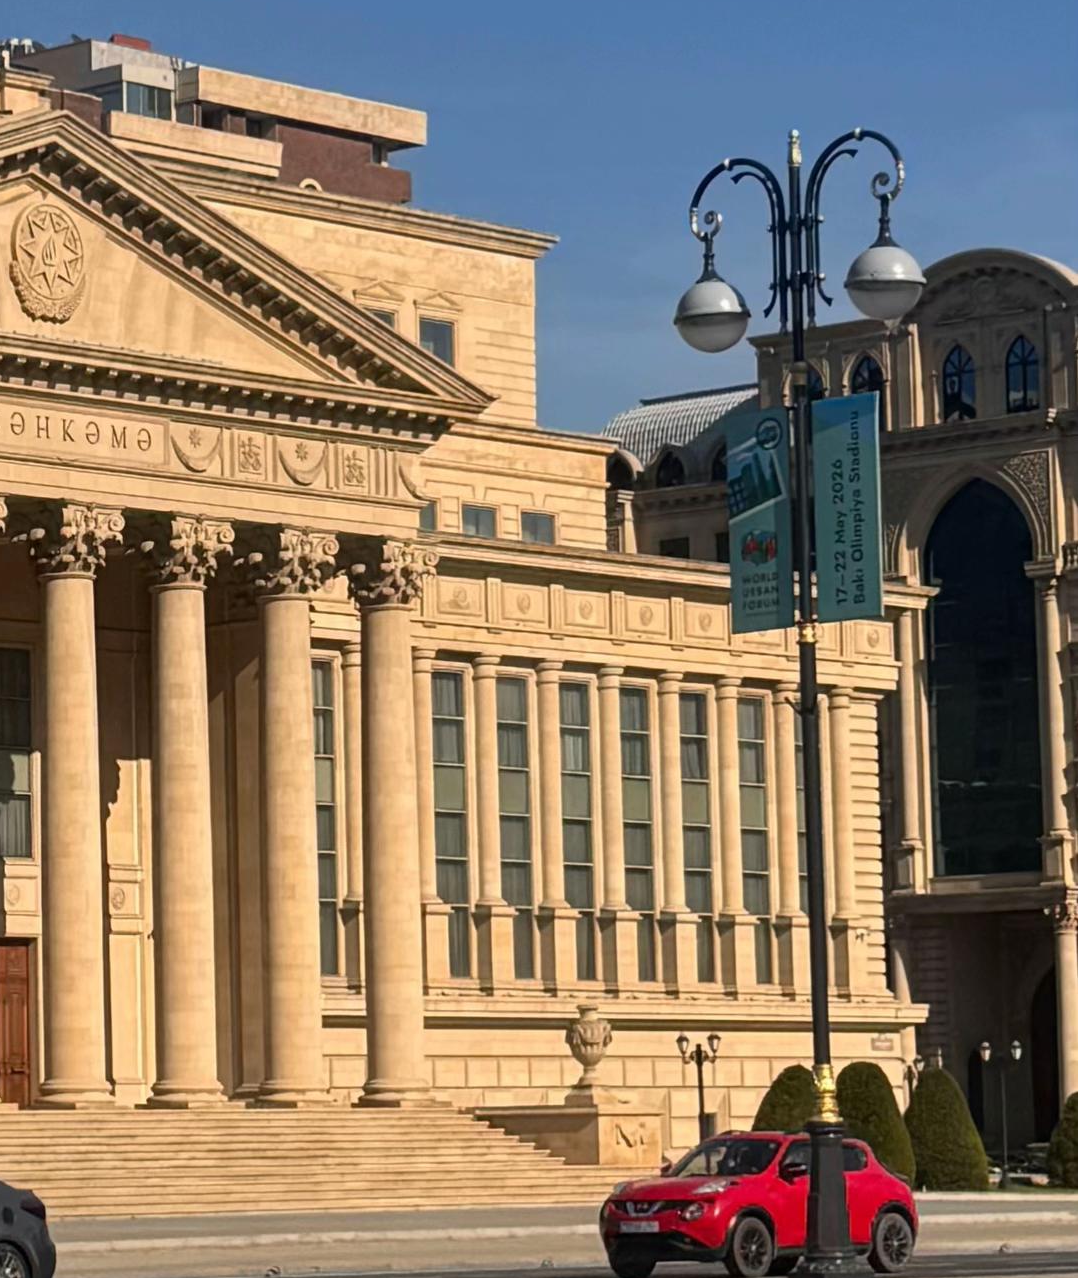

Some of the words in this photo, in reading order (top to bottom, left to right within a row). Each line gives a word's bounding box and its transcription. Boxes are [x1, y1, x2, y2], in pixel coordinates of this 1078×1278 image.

[831, 458, 844, 505] 2026
[833, 510, 847, 544] May
[850, 489, 866, 562] Olimpiya
